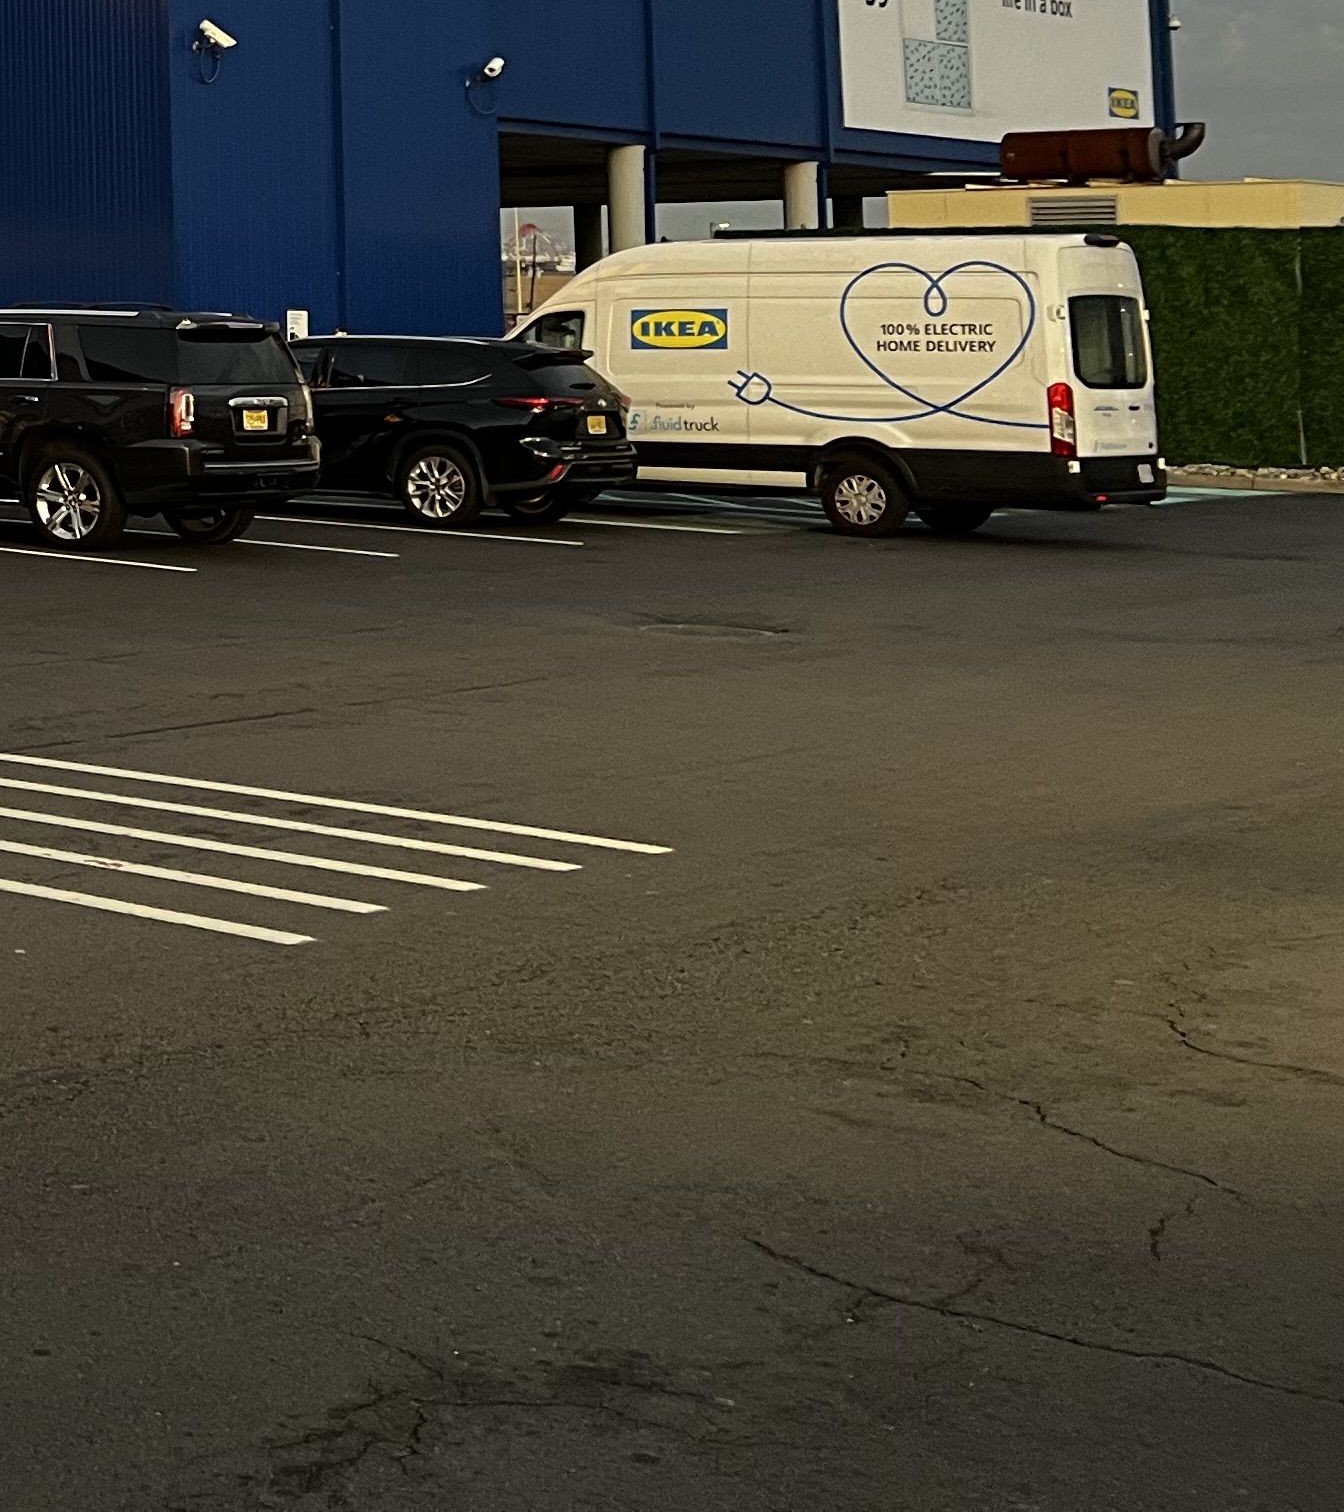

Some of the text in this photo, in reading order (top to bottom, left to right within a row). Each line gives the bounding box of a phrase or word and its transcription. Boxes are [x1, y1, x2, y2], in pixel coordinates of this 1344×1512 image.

[640, 320, 719, 336] IKEA
[880, 323, 994, 335] 100% ELECTRIC
[876, 340, 997, 352] HOME DELIVERY
